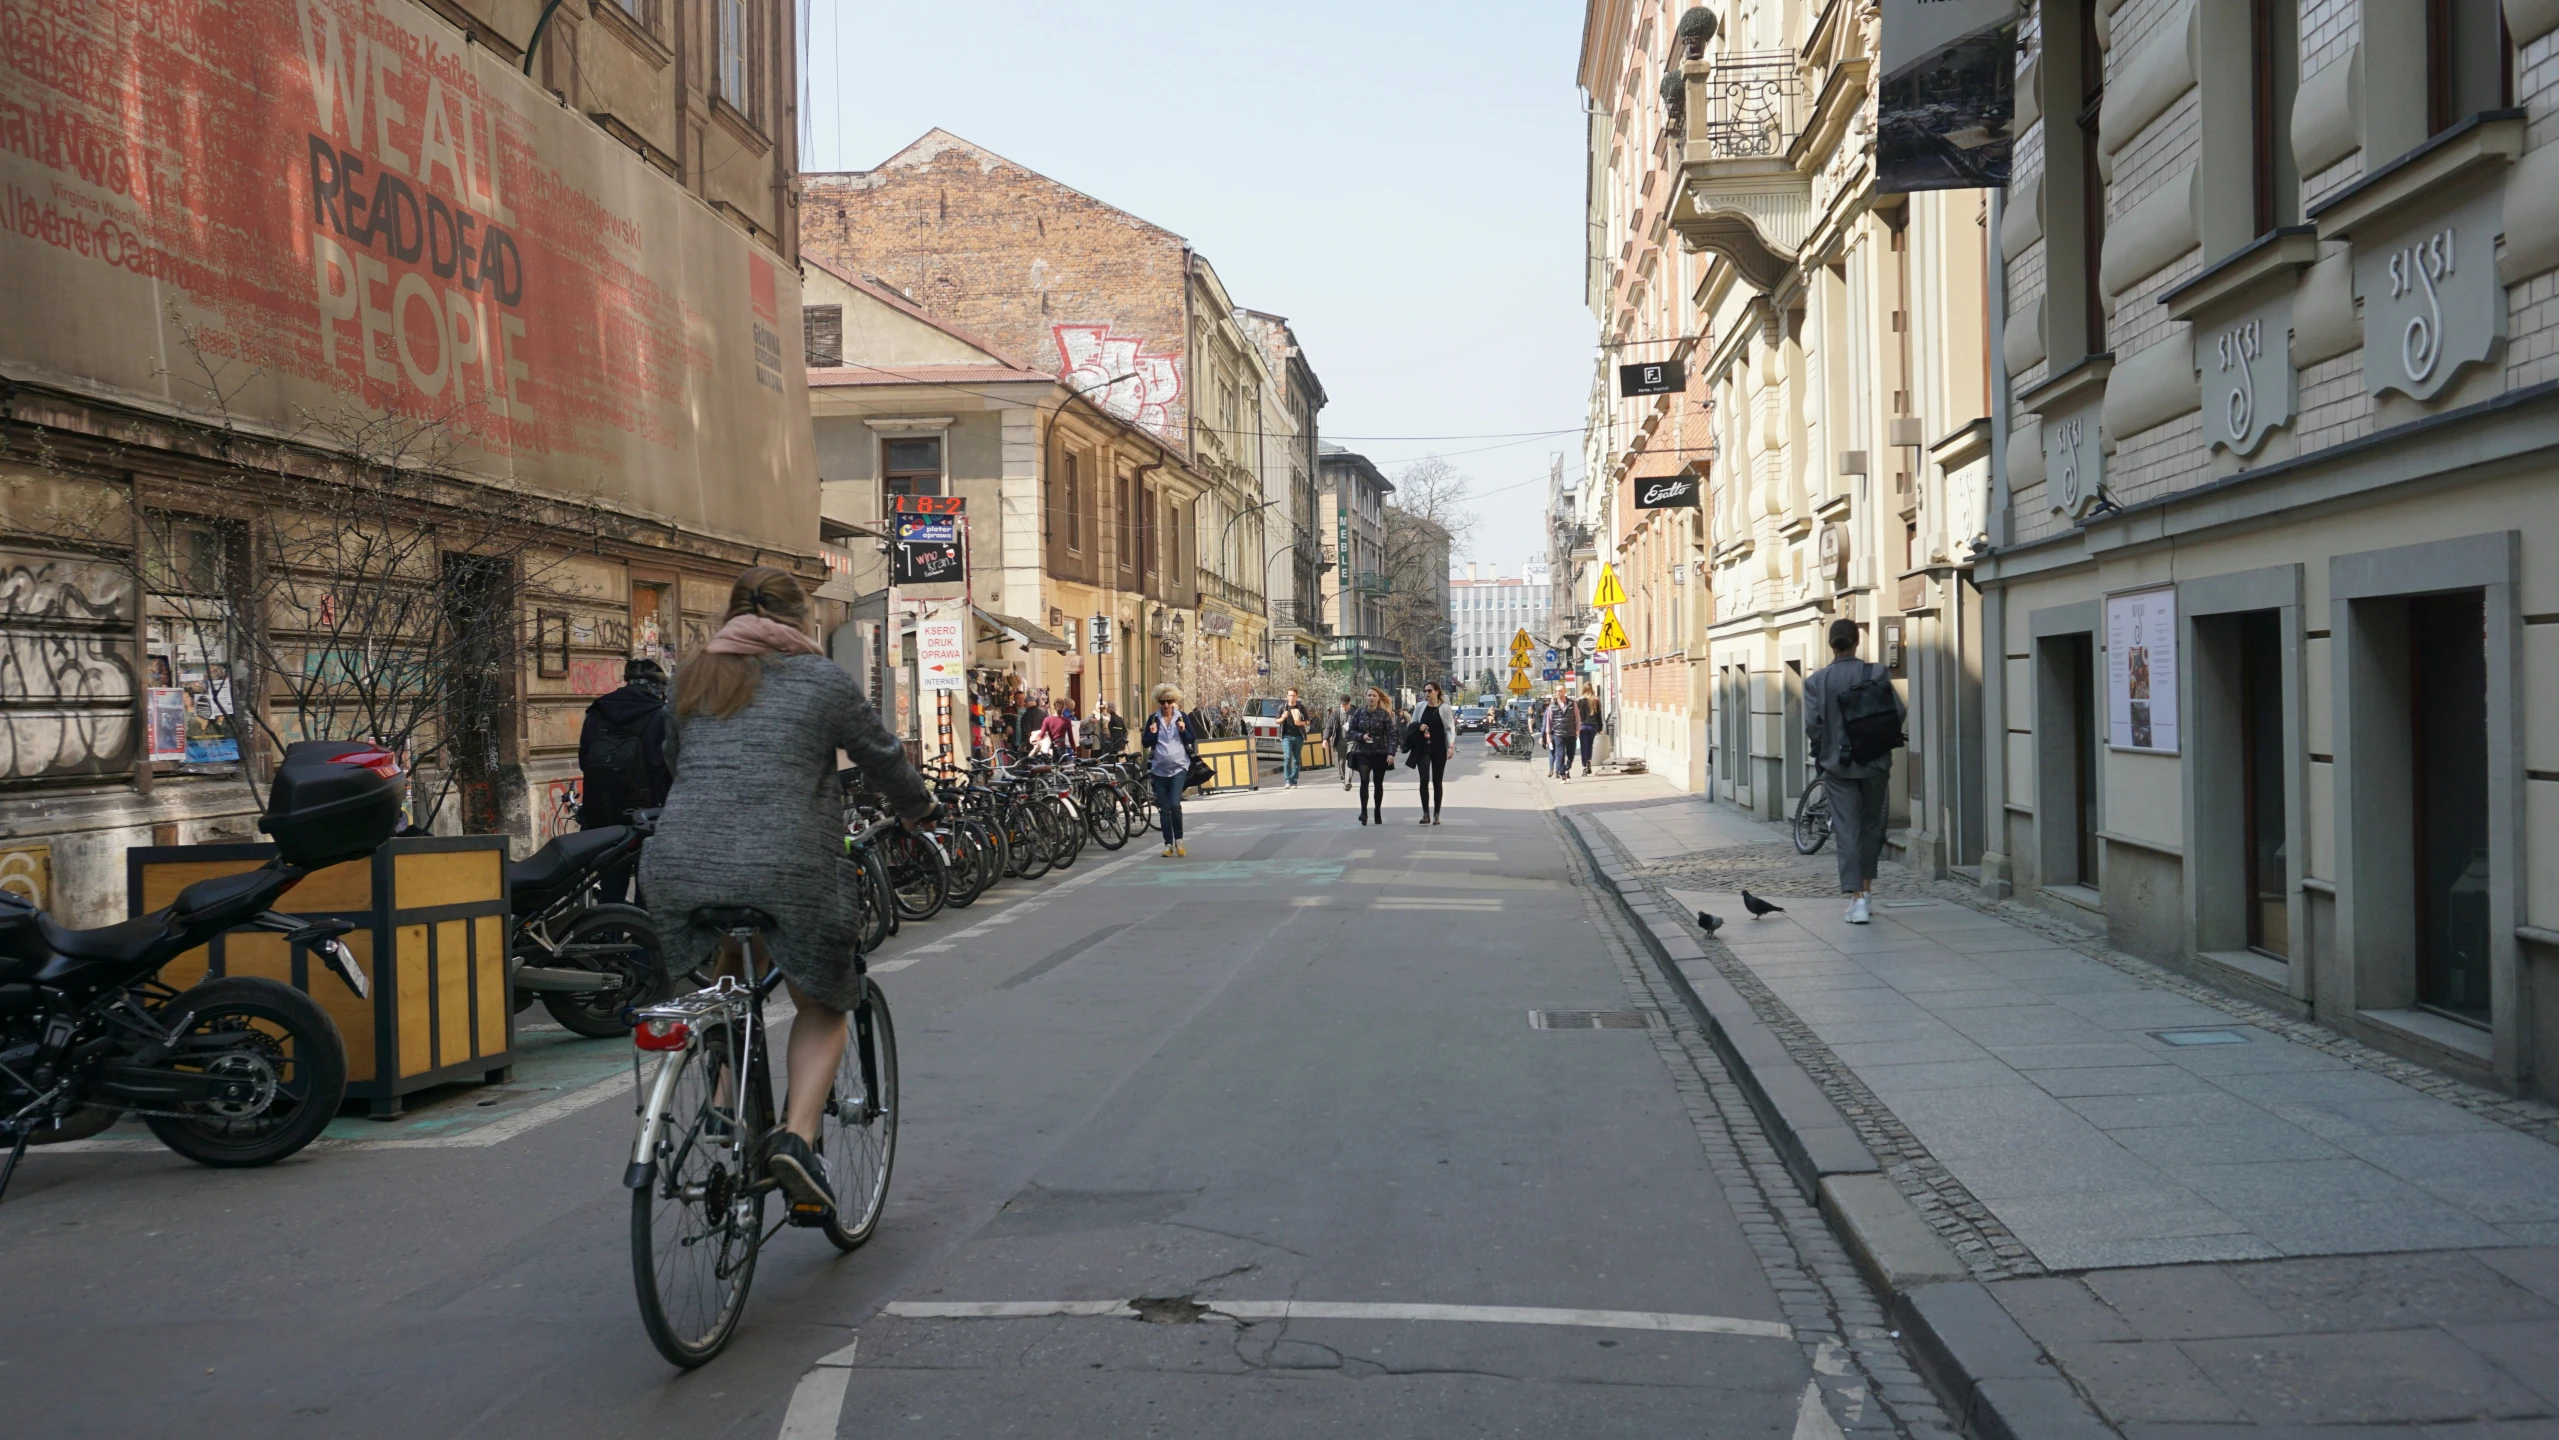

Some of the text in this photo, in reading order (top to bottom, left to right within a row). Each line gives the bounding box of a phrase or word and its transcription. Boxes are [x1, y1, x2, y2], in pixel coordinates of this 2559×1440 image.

[362, 0, 420, 57] Franz
[425, 34, 478, 98] Kafka
[295, 0, 411, 176] WE
[417, 75, 517, 229] ALL
[50, 179, 136, 227] Virginia Woolf
[308, 132, 423, 265] READ
[425, 192, 523, 307] DEAD
[551, 167, 642, 251] Dostojewski
[313, 232, 535, 424] PEOPLE
[2389, 228, 2454, 382] SISSI
[2219, 319, 2262, 440] SISSI
[2058, 418, 2082, 506] SISSI
[915, 551, 937, 565] wino
[926, 557, 950, 571] kran
[1339, 516, 1348, 578] MEBLE
[921, 650, 961, 659] OPRAWA
[924, 626, 956, 636] KSERO
[928, 638, 954, 647] DRUK
[924, 678, 959, 686] INTERNET
